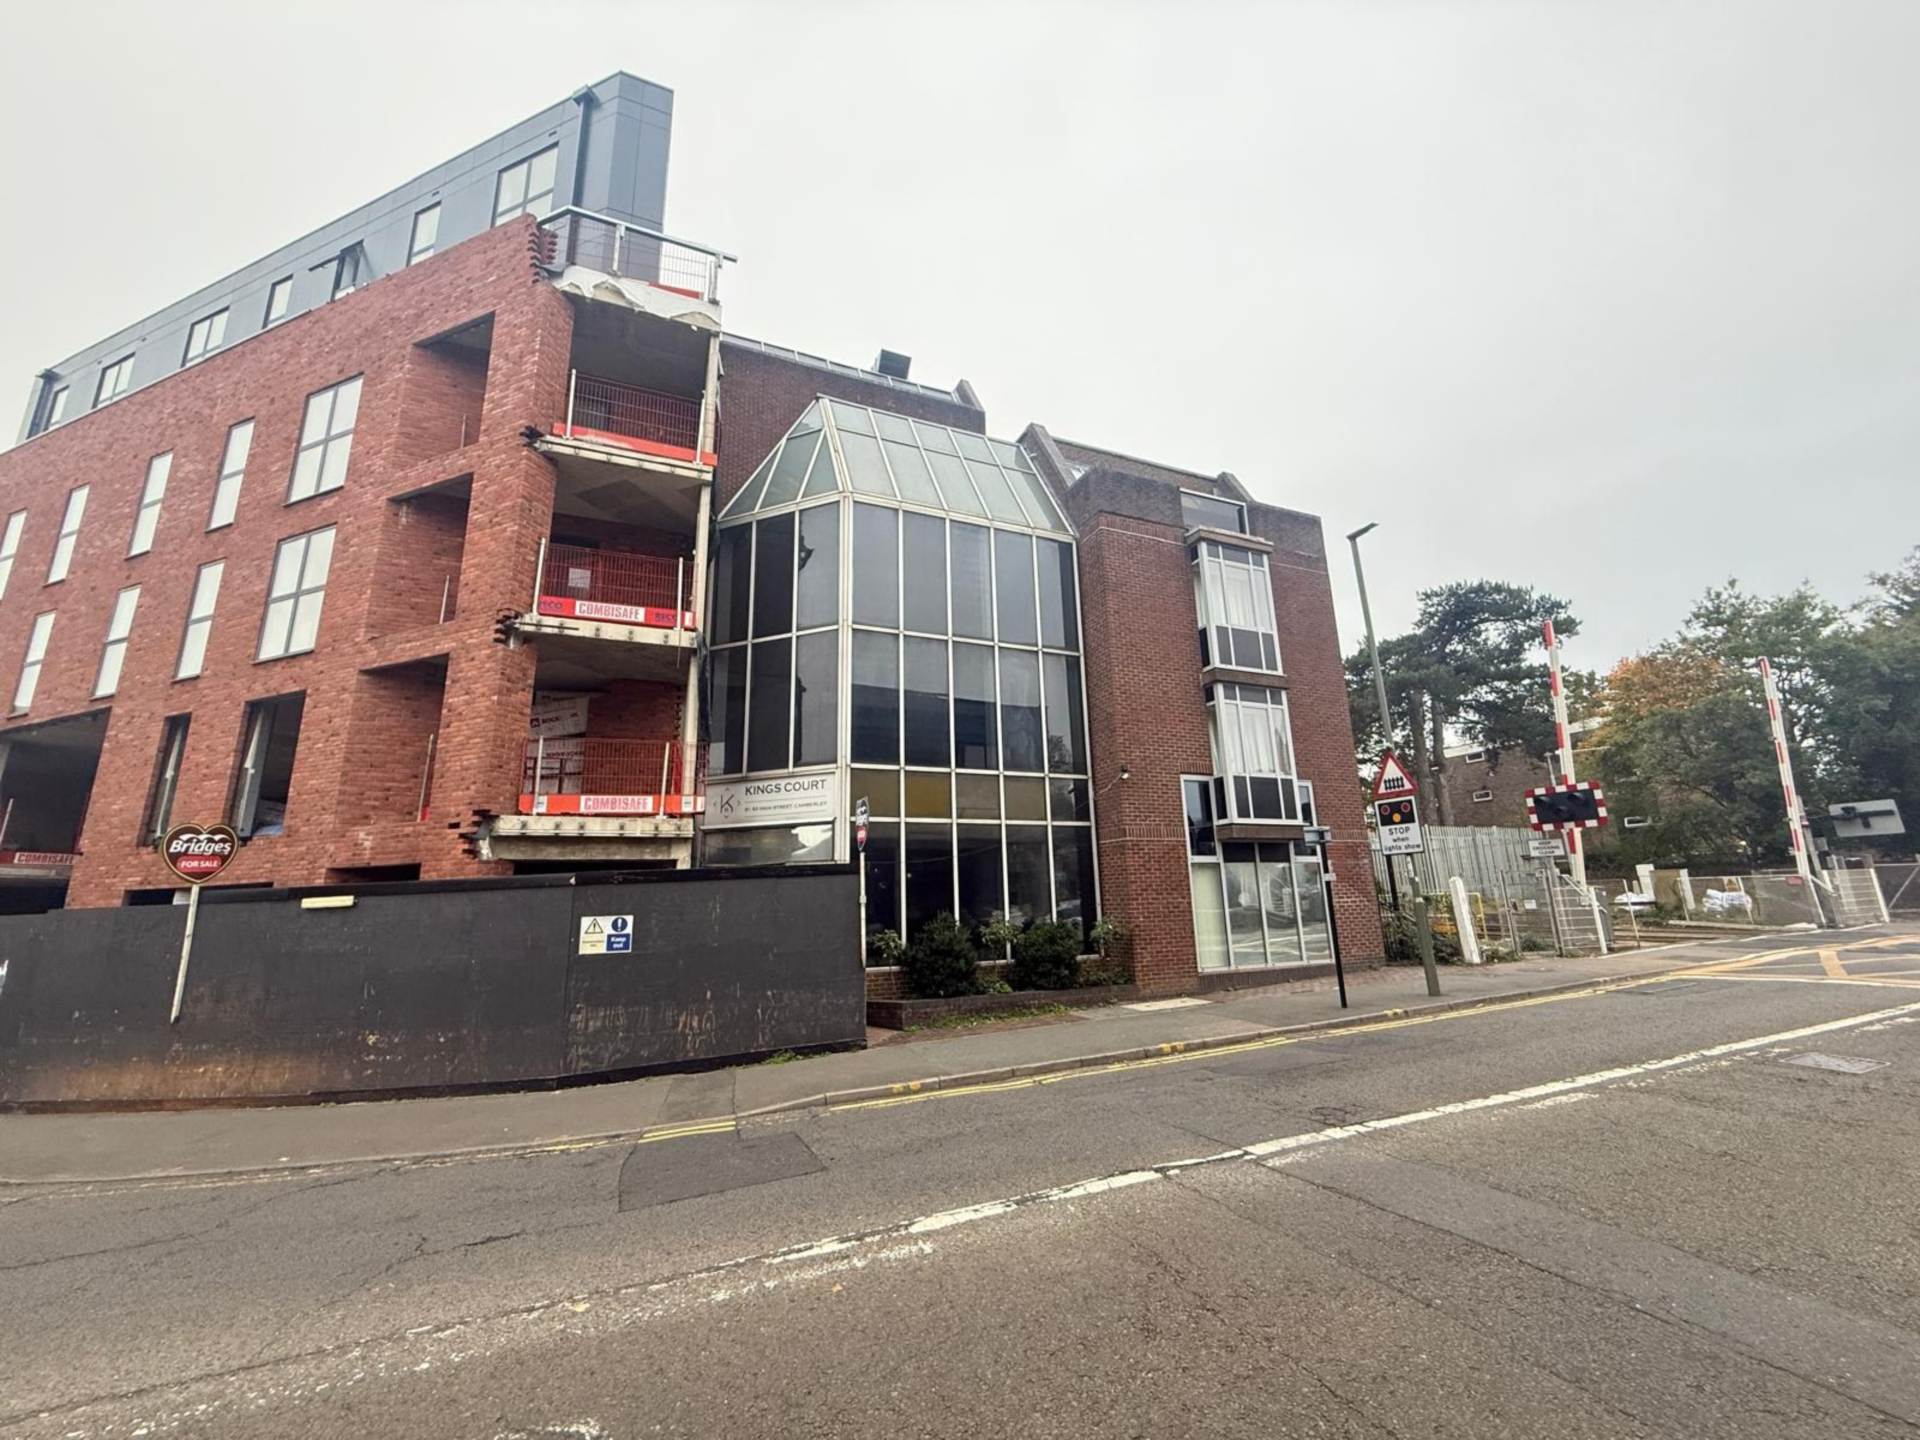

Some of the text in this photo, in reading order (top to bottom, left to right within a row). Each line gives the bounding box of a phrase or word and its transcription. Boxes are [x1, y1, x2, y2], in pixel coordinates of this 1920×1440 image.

[578, 602, 640, 620] COMBISAFE
[745, 780, 826, 796] KINGS COURT
[584, 797, 649, 811] COMBISAFE
[1388, 826, 1410, 836] STOP
[169, 838, 232, 856] Bridges
[200, 860, 218, 868] SALE
